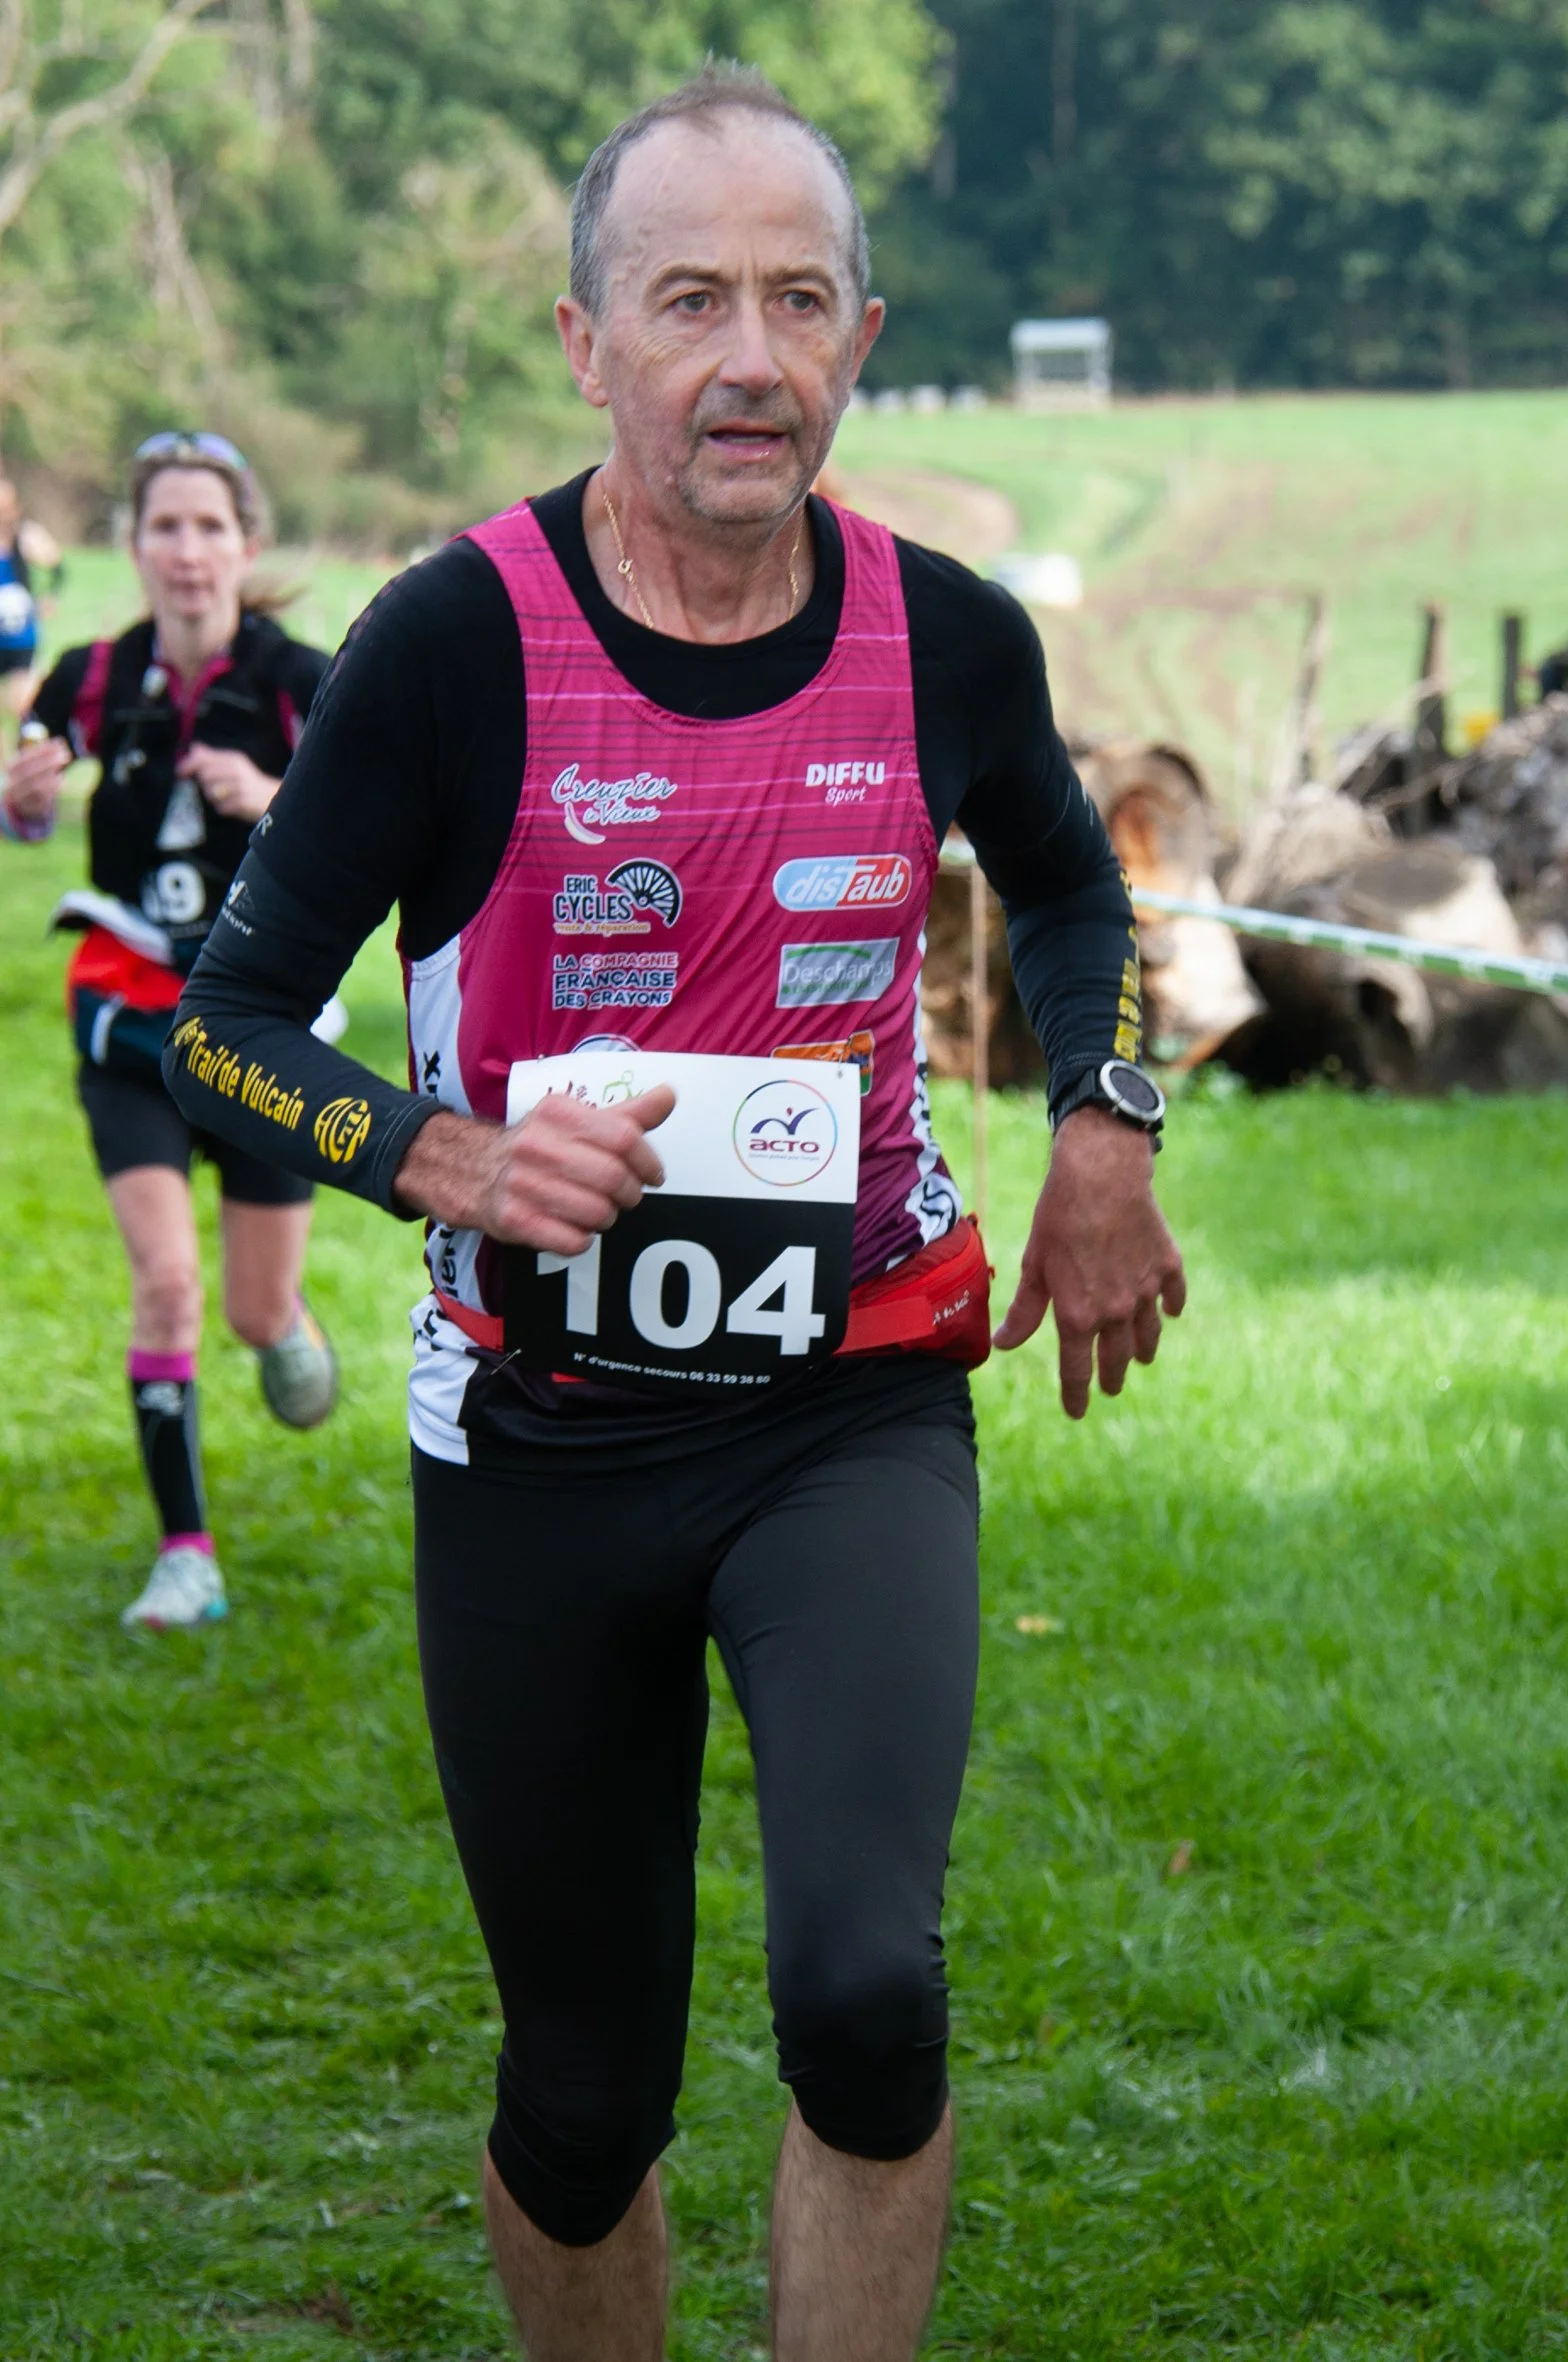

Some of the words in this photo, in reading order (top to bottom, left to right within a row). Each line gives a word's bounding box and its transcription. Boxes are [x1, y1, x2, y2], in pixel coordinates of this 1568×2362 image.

[552, 764, 677, 802] Creuzier
[804, 761, 886, 787] DIFFU
[825, 785, 867, 807] Sport
[566, 877, 596, 893] ERIC
[555, 895, 632, 920] CYCLES
[555, 956, 576, 969] LA
[580, 952, 677, 968] COMPAGNIE
[555, 971, 675, 989] FRANÇAISE
[555, 994, 586, 1008] DES
[589, 990, 670, 1006] CRAYONS
[217, 1053, 241, 1098] de
[241, 1061, 304, 1131] Vulcain
[536, 1234, 826, 1356] 104
[643, 1366, 688, 1381] secours
